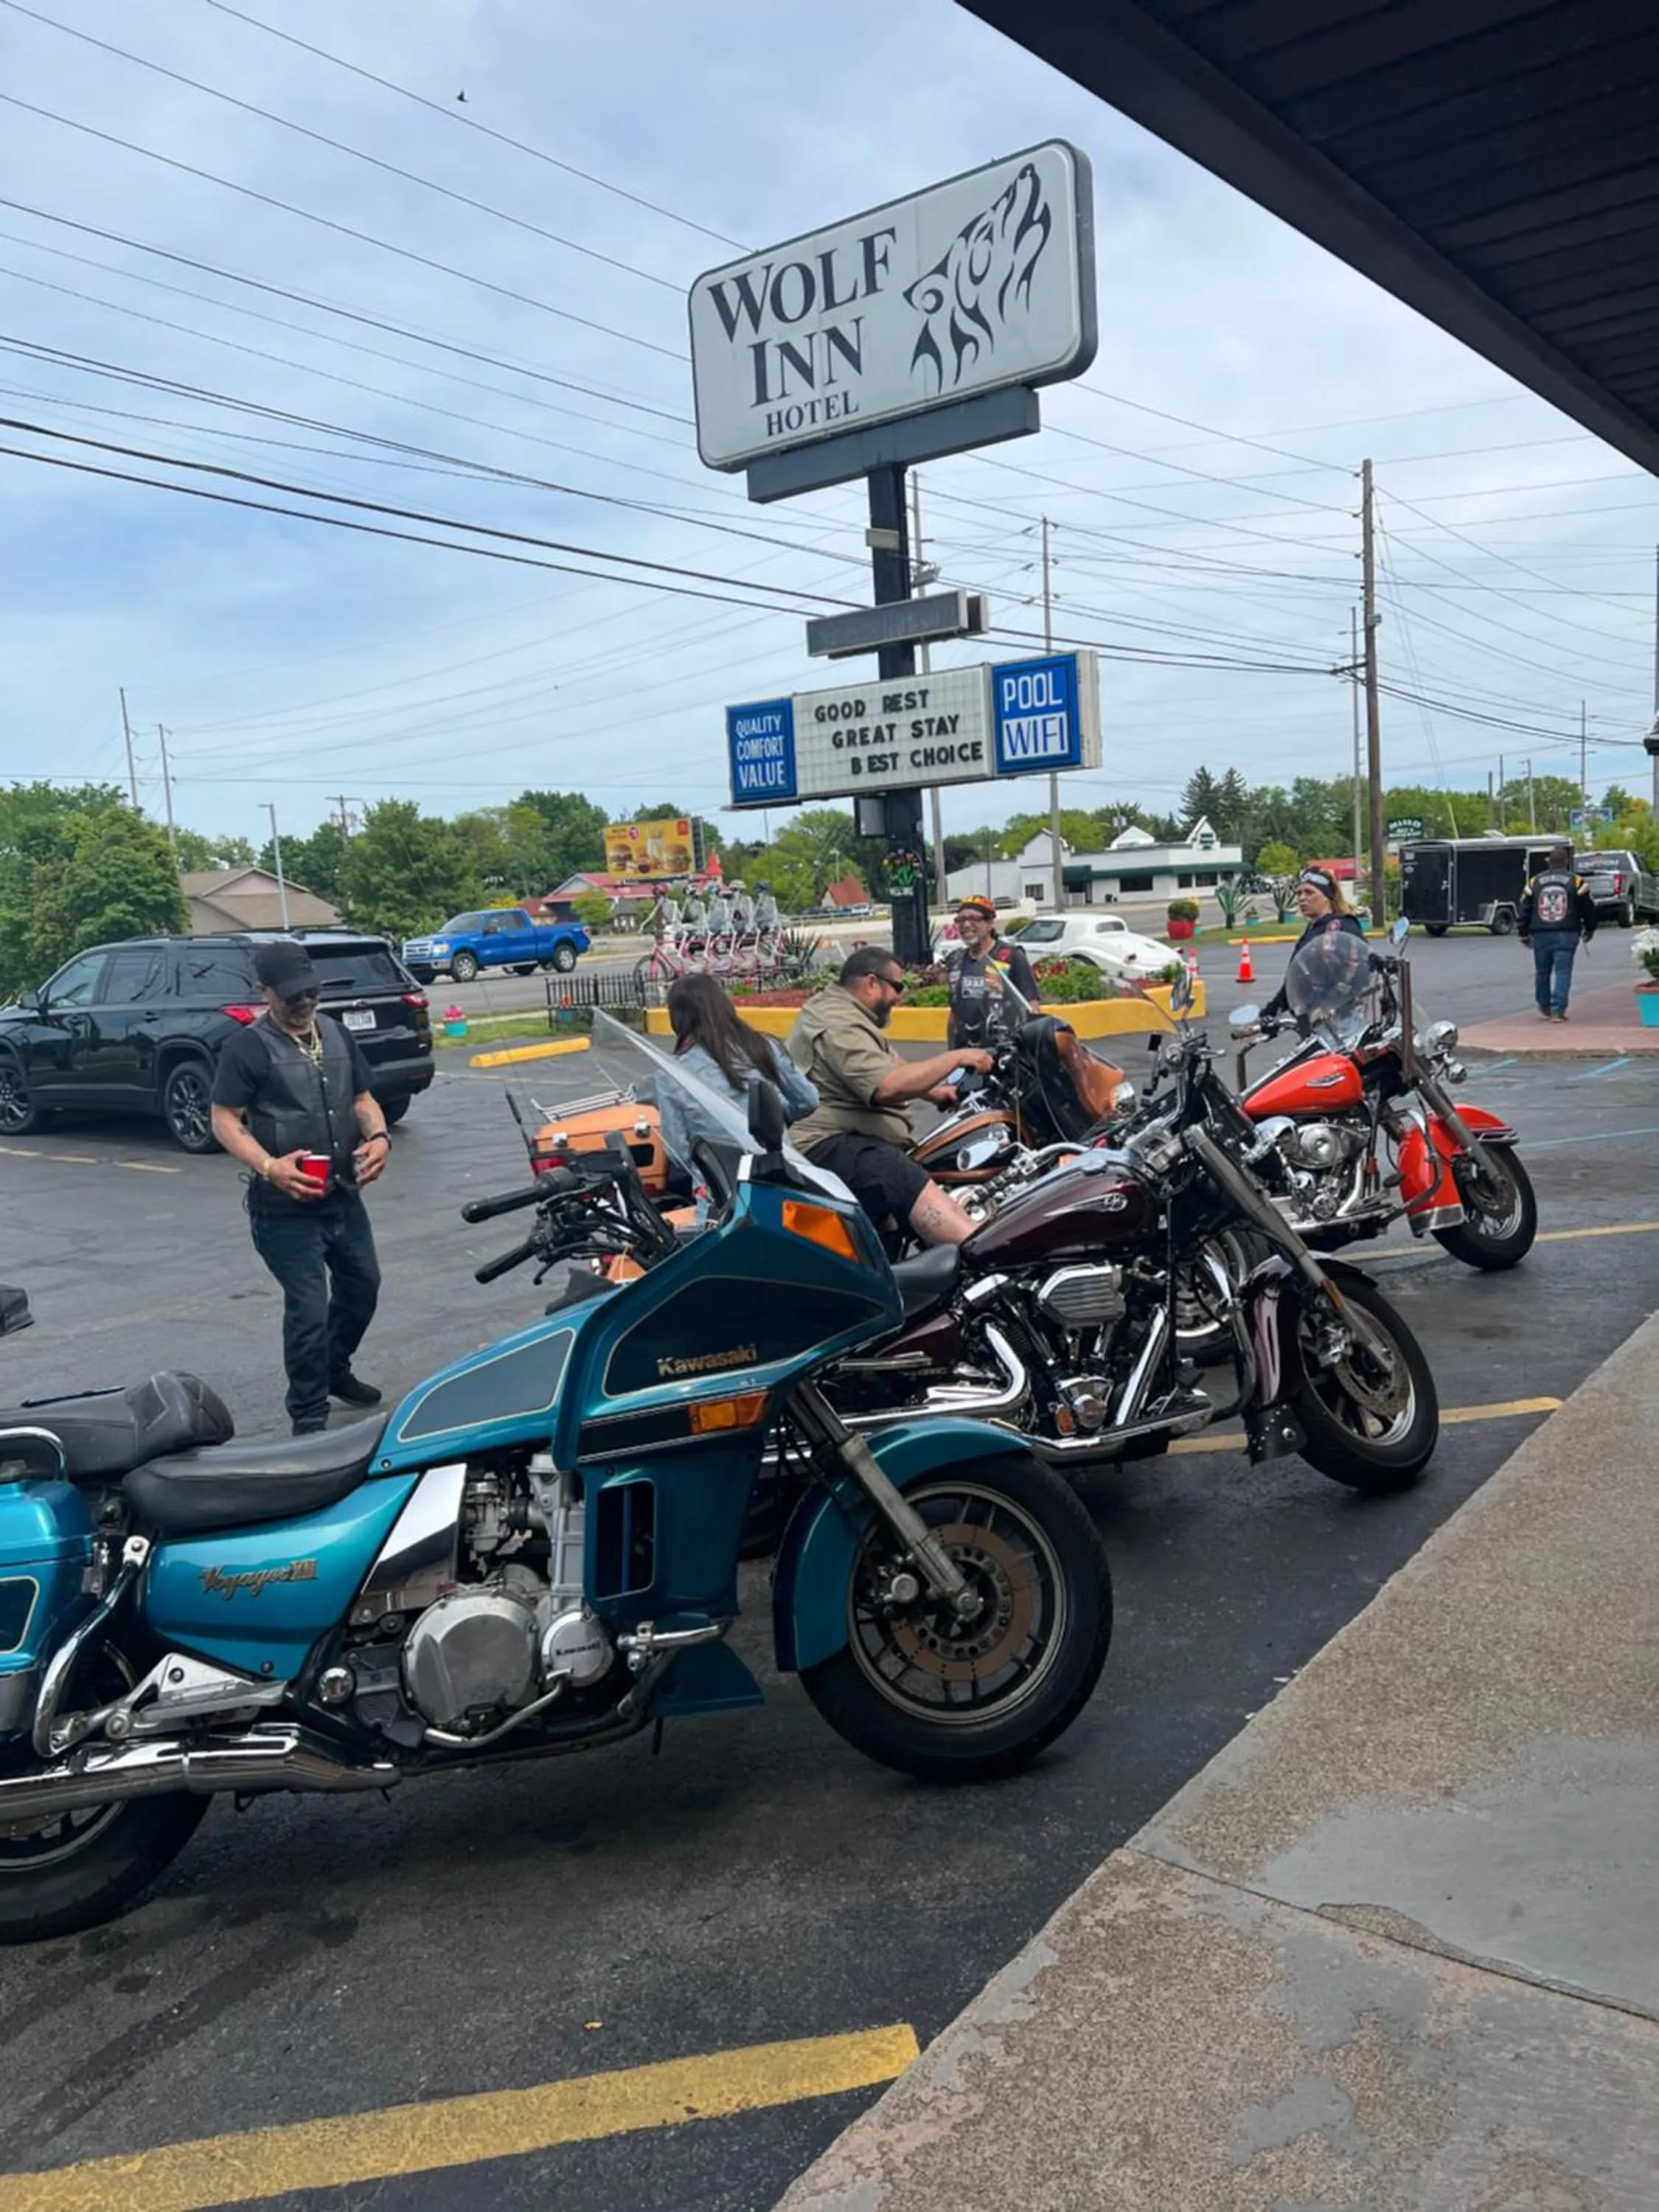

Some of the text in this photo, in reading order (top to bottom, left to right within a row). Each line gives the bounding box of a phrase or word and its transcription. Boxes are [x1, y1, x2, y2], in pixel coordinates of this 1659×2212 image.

[707, 226, 897, 344] WOLF
[747, 316, 866, 408] INN
[766, 391, 860, 437] HOTEL
[815, 689, 929, 723] GOOD REST
[1004, 671, 1063, 713] POOL
[736, 714, 782, 739] QUALITY
[832, 714, 960, 749] GREAT STAY
[1005, 716, 1065, 757] WIFI
[737, 735, 784, 761] COMFORT
[851, 740, 984, 775] BEST CHOICE
[738, 760, 786, 790] VALUE
[656, 1344, 758, 1377] Kawasaki
